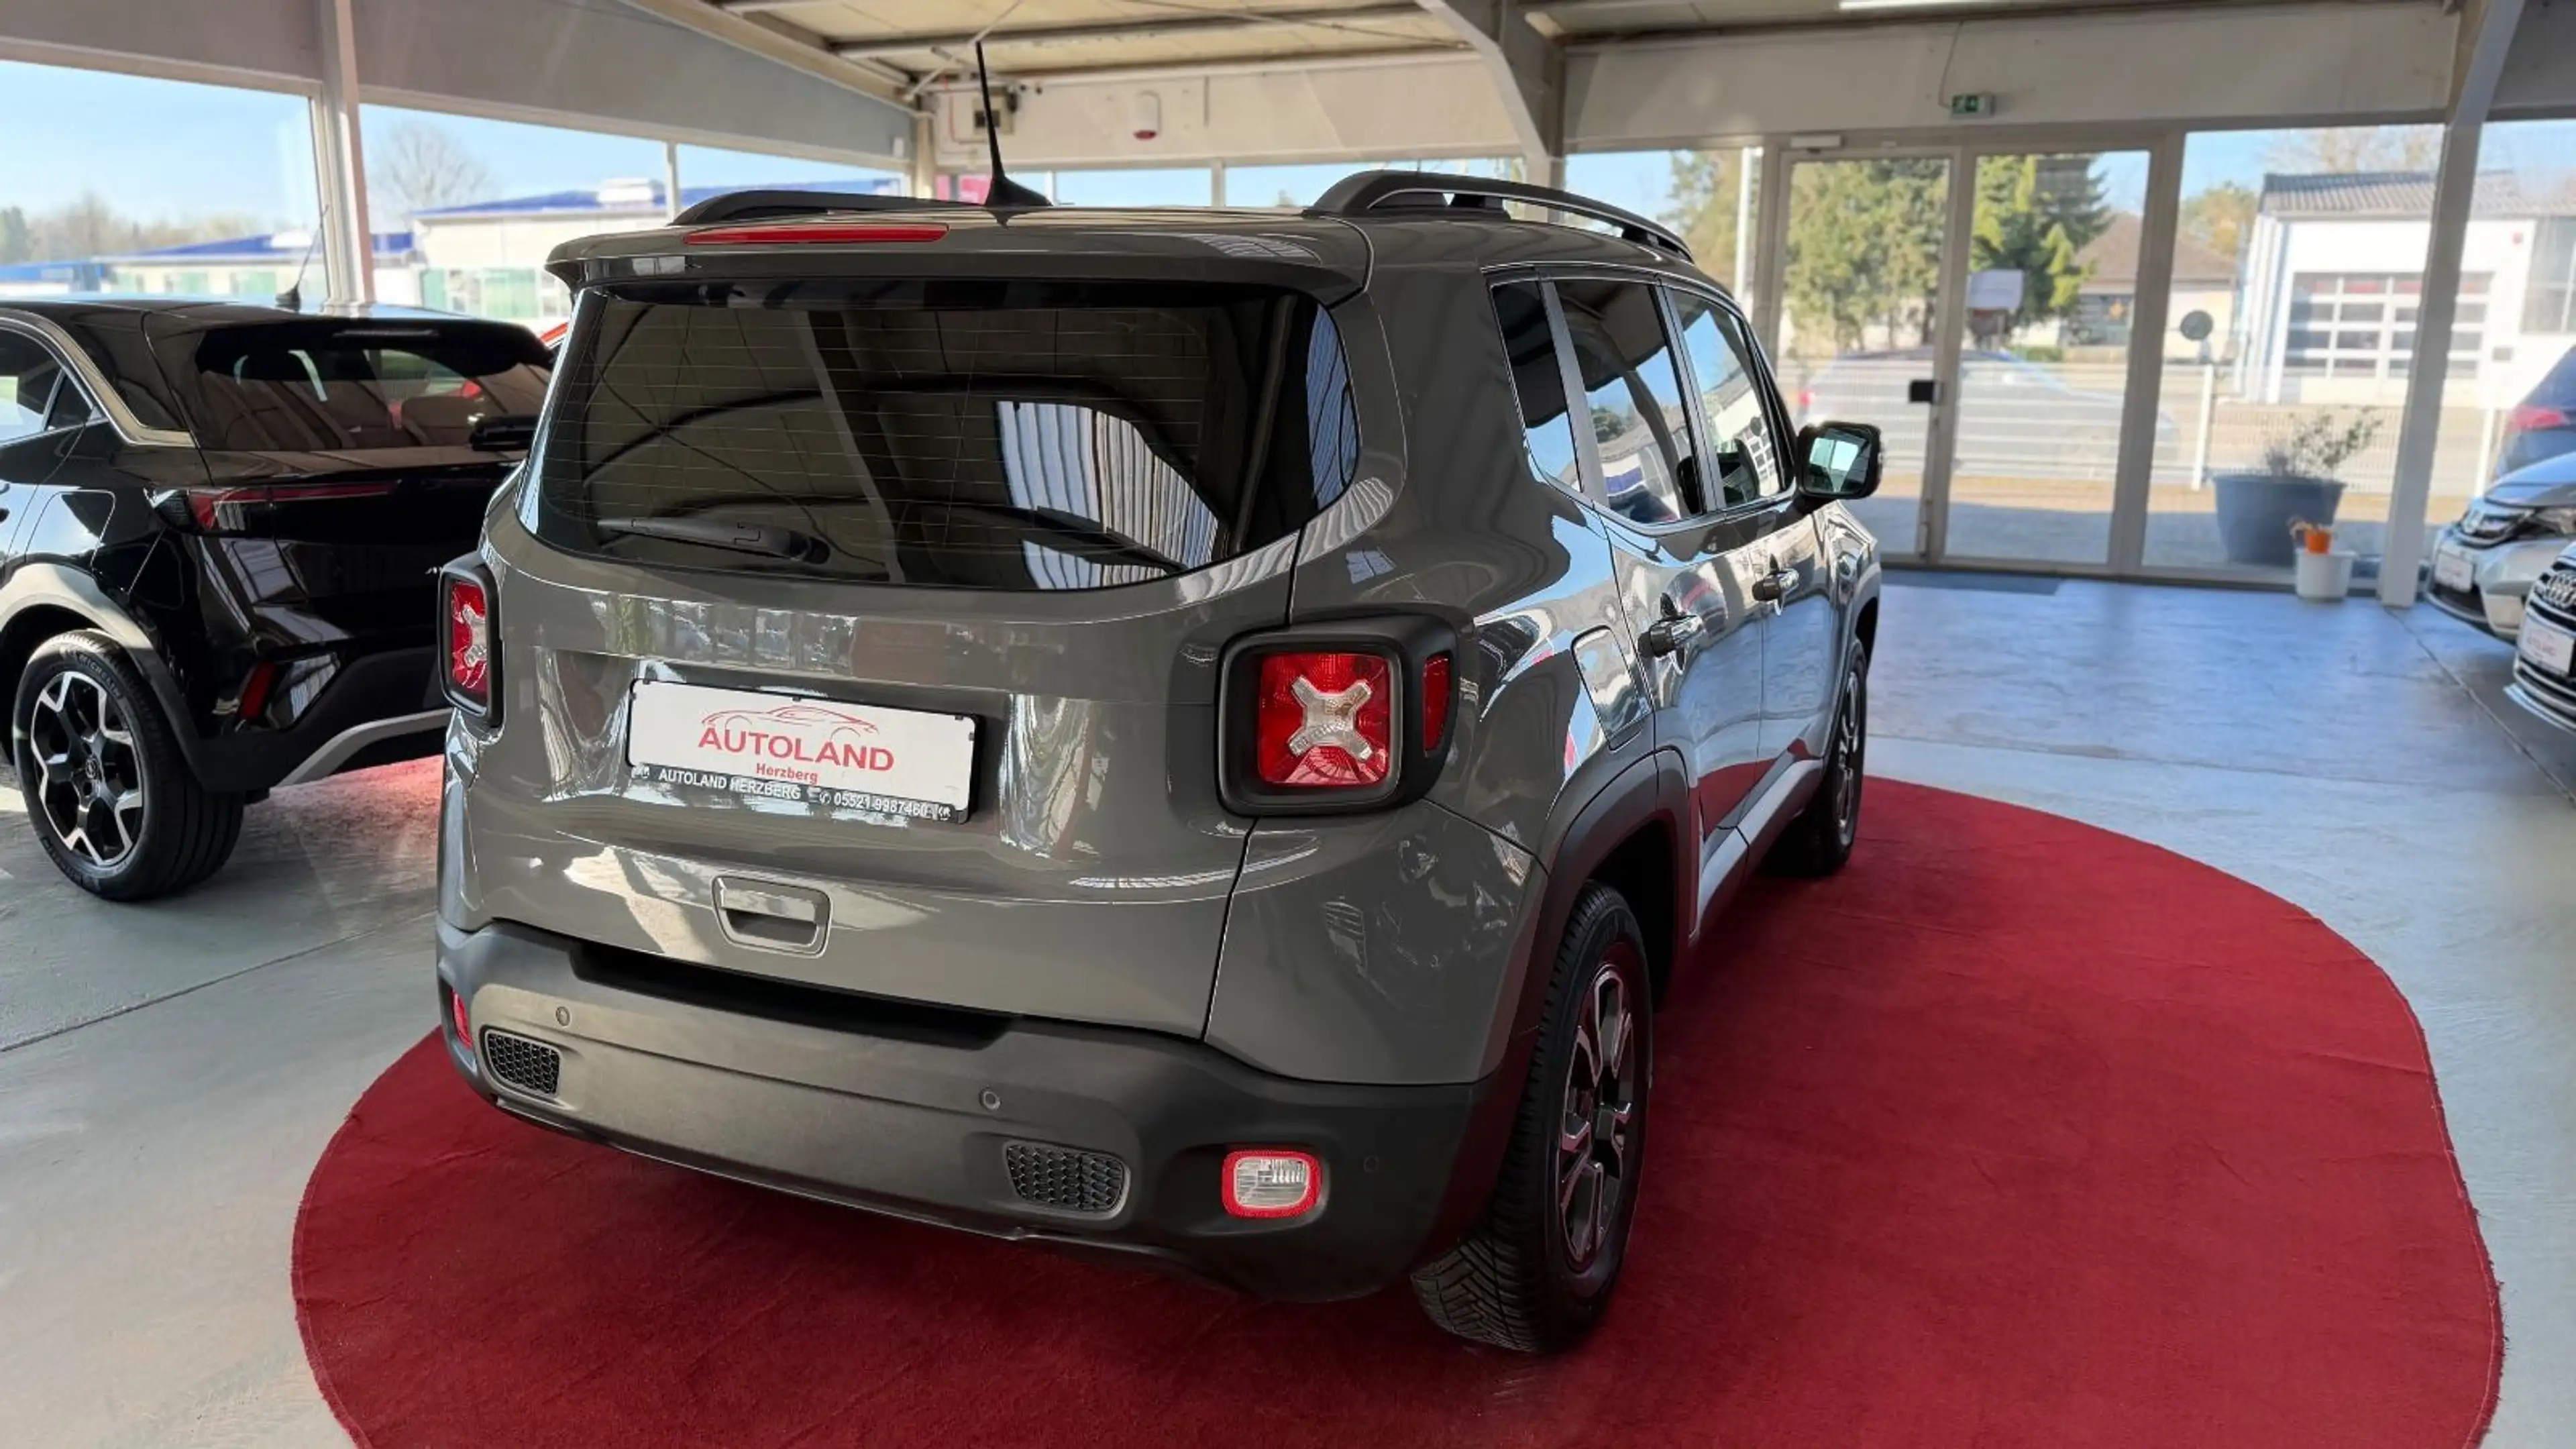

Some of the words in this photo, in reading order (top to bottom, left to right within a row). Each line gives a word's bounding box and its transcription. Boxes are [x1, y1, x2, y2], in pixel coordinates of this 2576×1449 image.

[698, 727, 895, 771] AUTOLAND
[658, 768, 727, 790] AUTOLAND
[729, 776, 802, 800] HERZBERG
[756, 762, 818, 786] Herzberg
